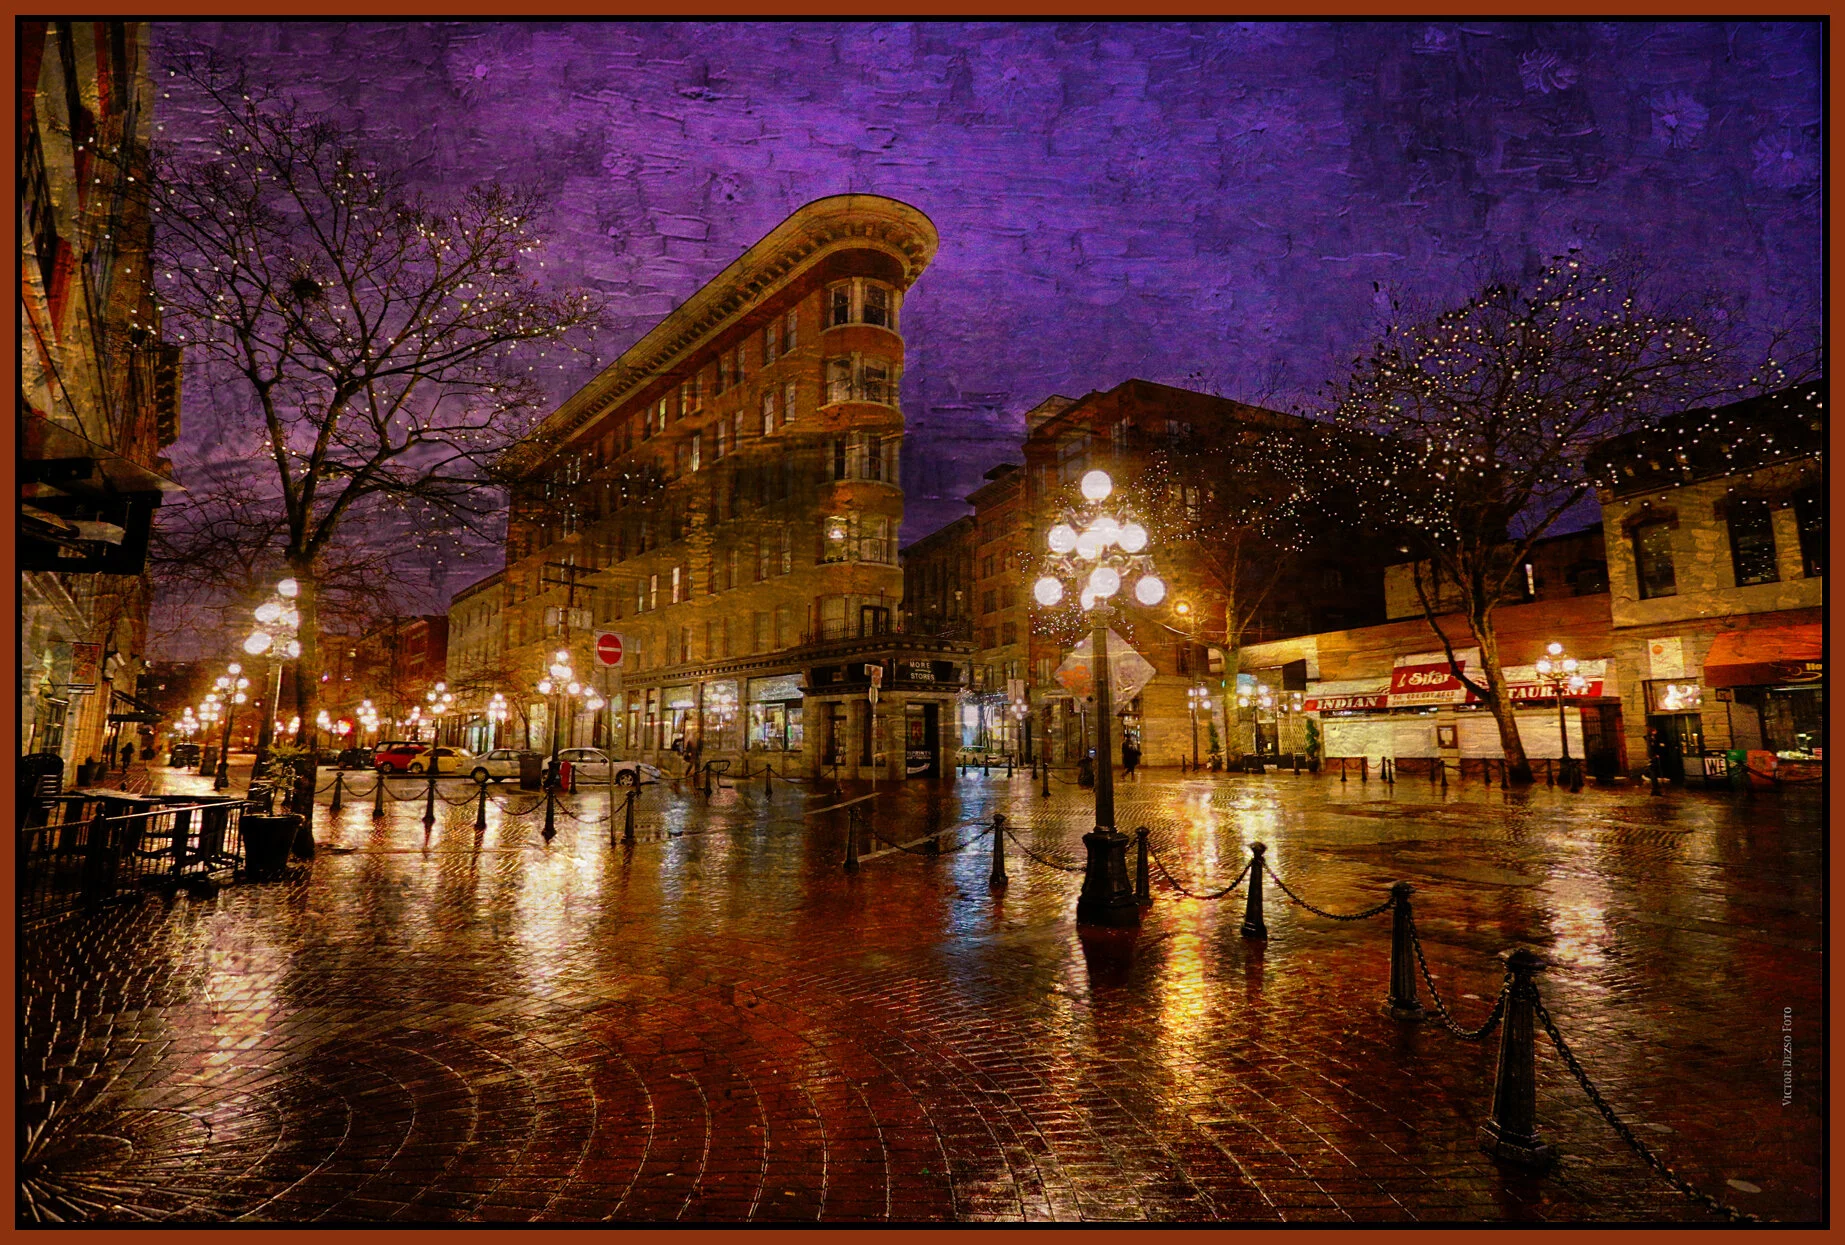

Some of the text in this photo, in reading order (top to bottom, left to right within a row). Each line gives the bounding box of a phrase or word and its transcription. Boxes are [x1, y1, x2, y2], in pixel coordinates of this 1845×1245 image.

[909, 661, 931, 669] MORE
[1408, 670, 1451, 686] Sitar
[1316, 697, 1378, 709] INDIAN
